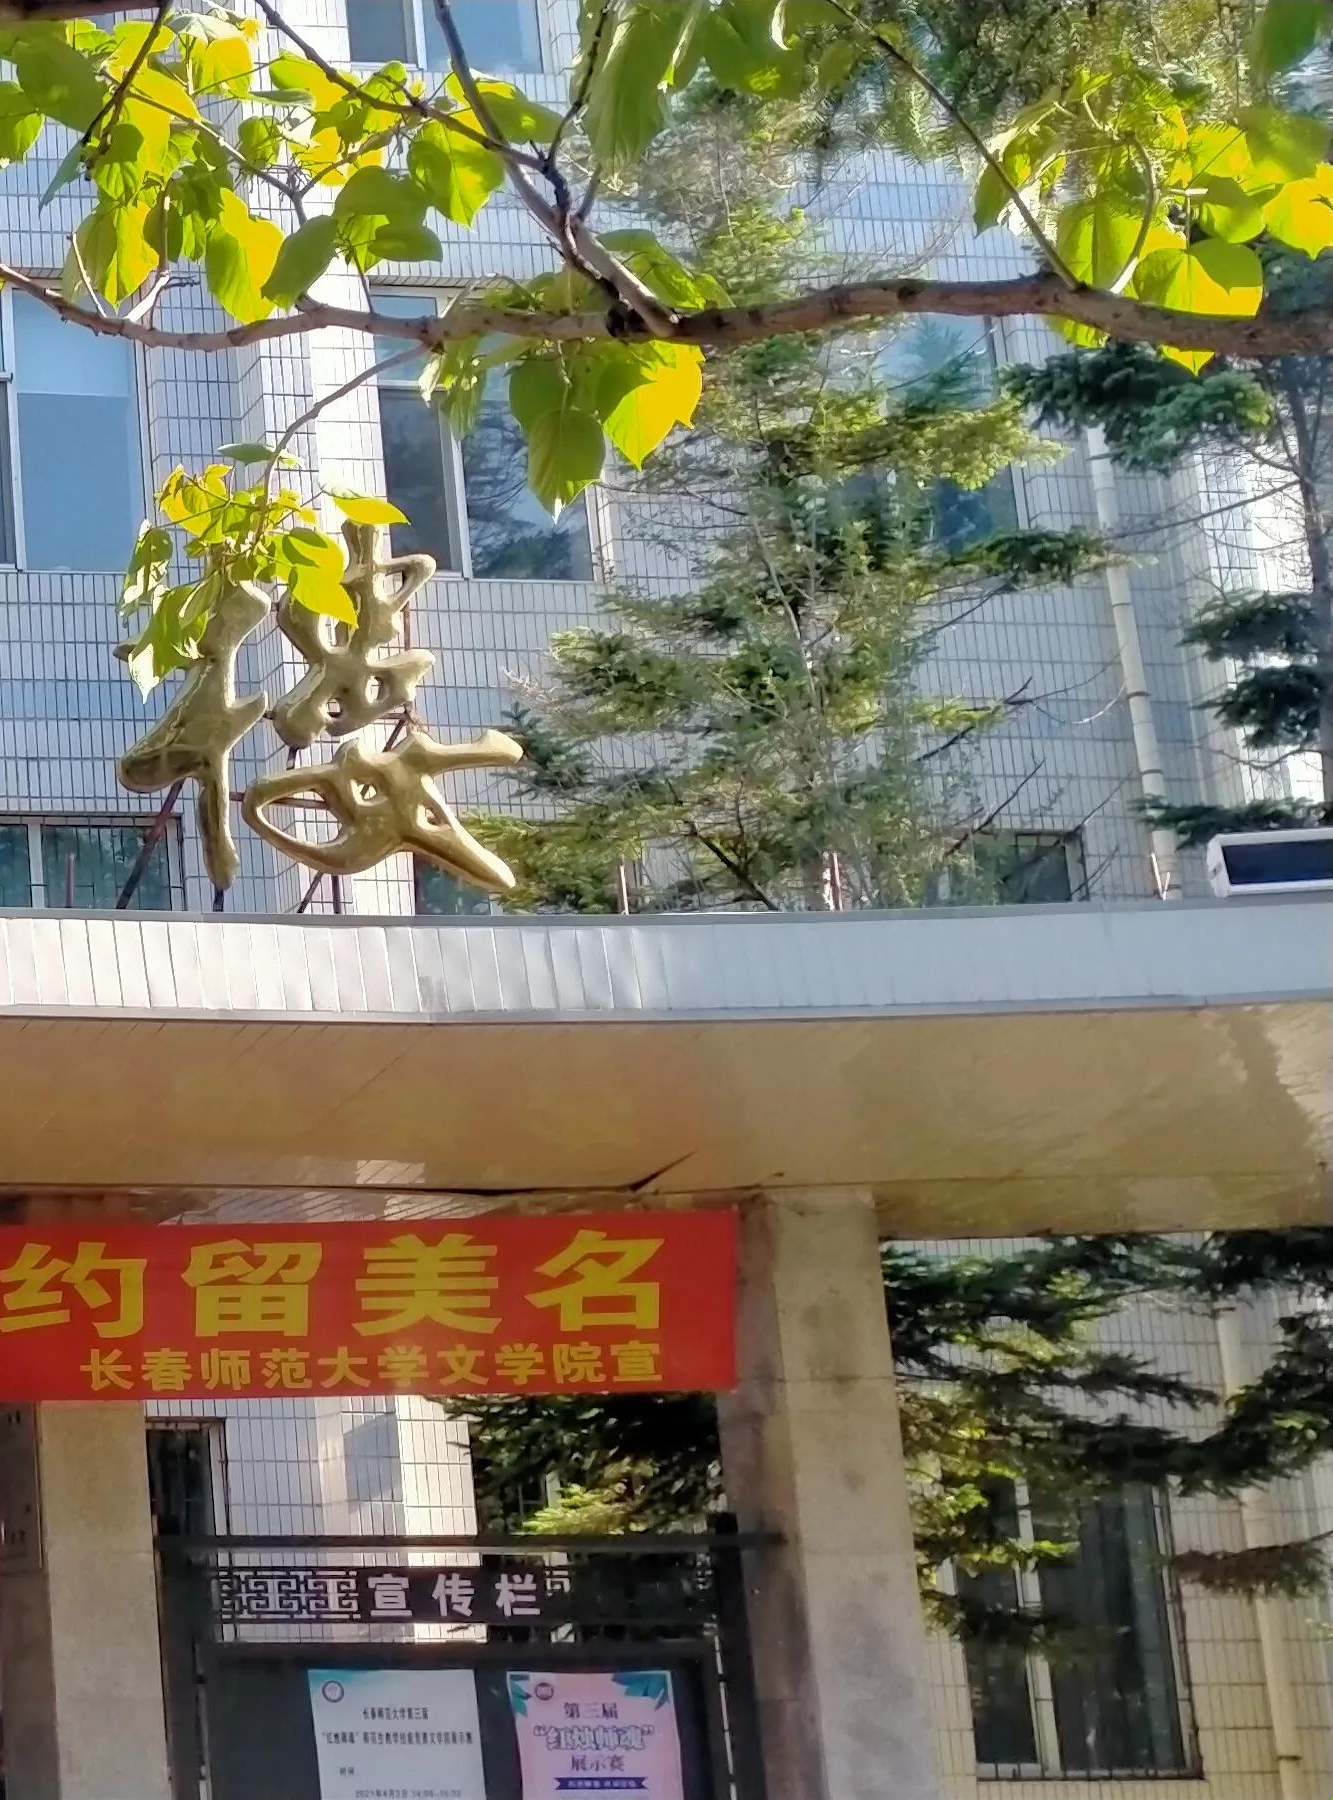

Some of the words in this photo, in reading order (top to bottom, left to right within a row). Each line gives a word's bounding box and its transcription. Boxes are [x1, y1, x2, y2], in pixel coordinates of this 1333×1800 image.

[79, 1340, 663, 1391] 长春师范大学文学院宣
[367, 1573, 541, 1617] 宣传栏
[564, 1702, 619, 1720] 第三届
[570, 1754, 626, 1772] 展示赛
